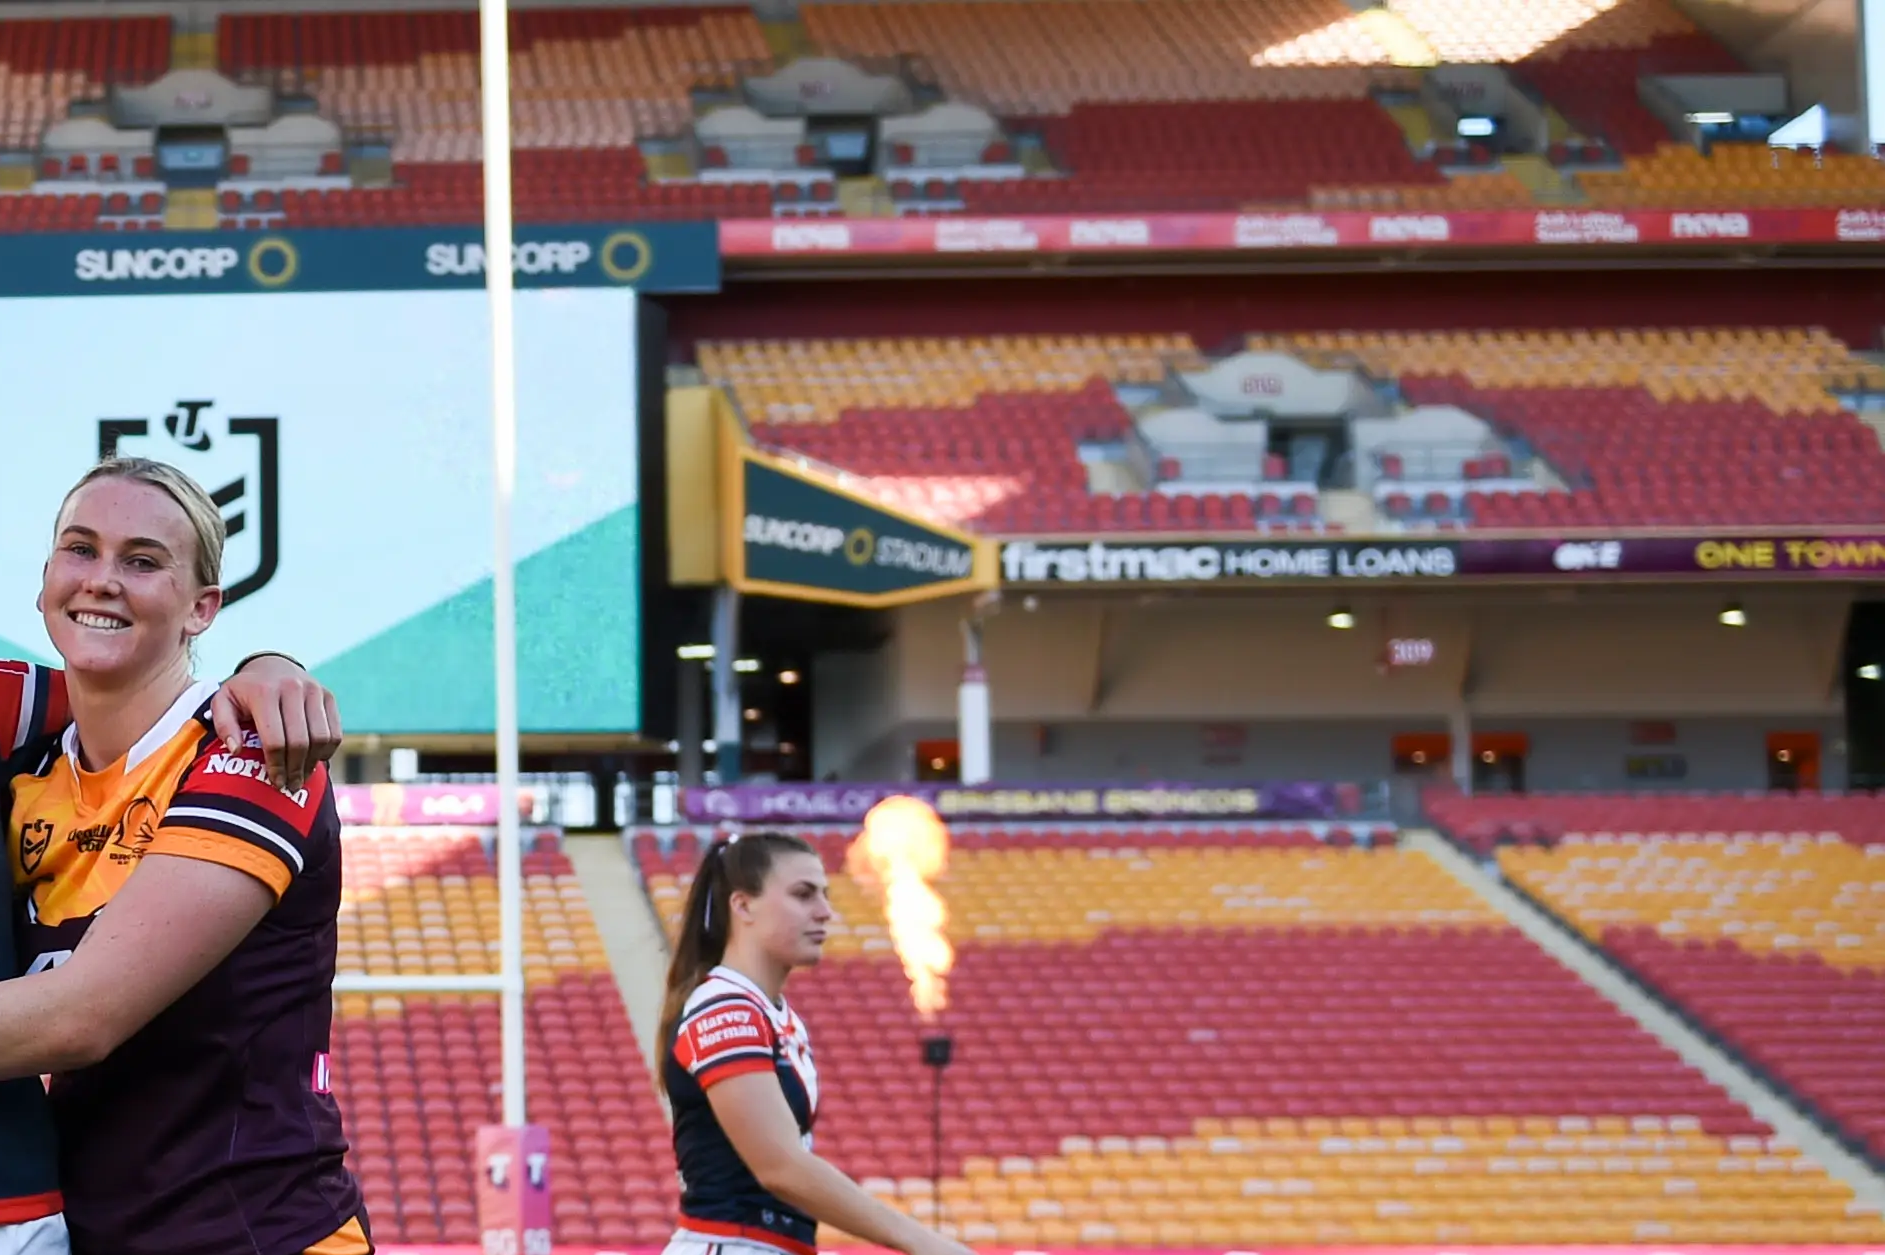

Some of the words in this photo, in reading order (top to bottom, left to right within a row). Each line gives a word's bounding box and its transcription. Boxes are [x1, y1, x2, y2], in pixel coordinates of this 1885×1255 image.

[74, 246, 239, 281] SUNCORP
[743, 512, 845, 556] SUNCORP
[873, 534, 973, 577] STADIUM
[1001, 541, 1219, 582] firstmac
[1224, 546, 1332, 577] HOME
[1336, 545, 1456, 578] LOANS
[1694, 539, 1776, 569] ONE
[1782, 539, 1885, 570] TOWN
[203, 753, 309, 809] Norn
[695, 1010, 752, 1034] Harvey
[697, 1024, 760, 1050] Norman
